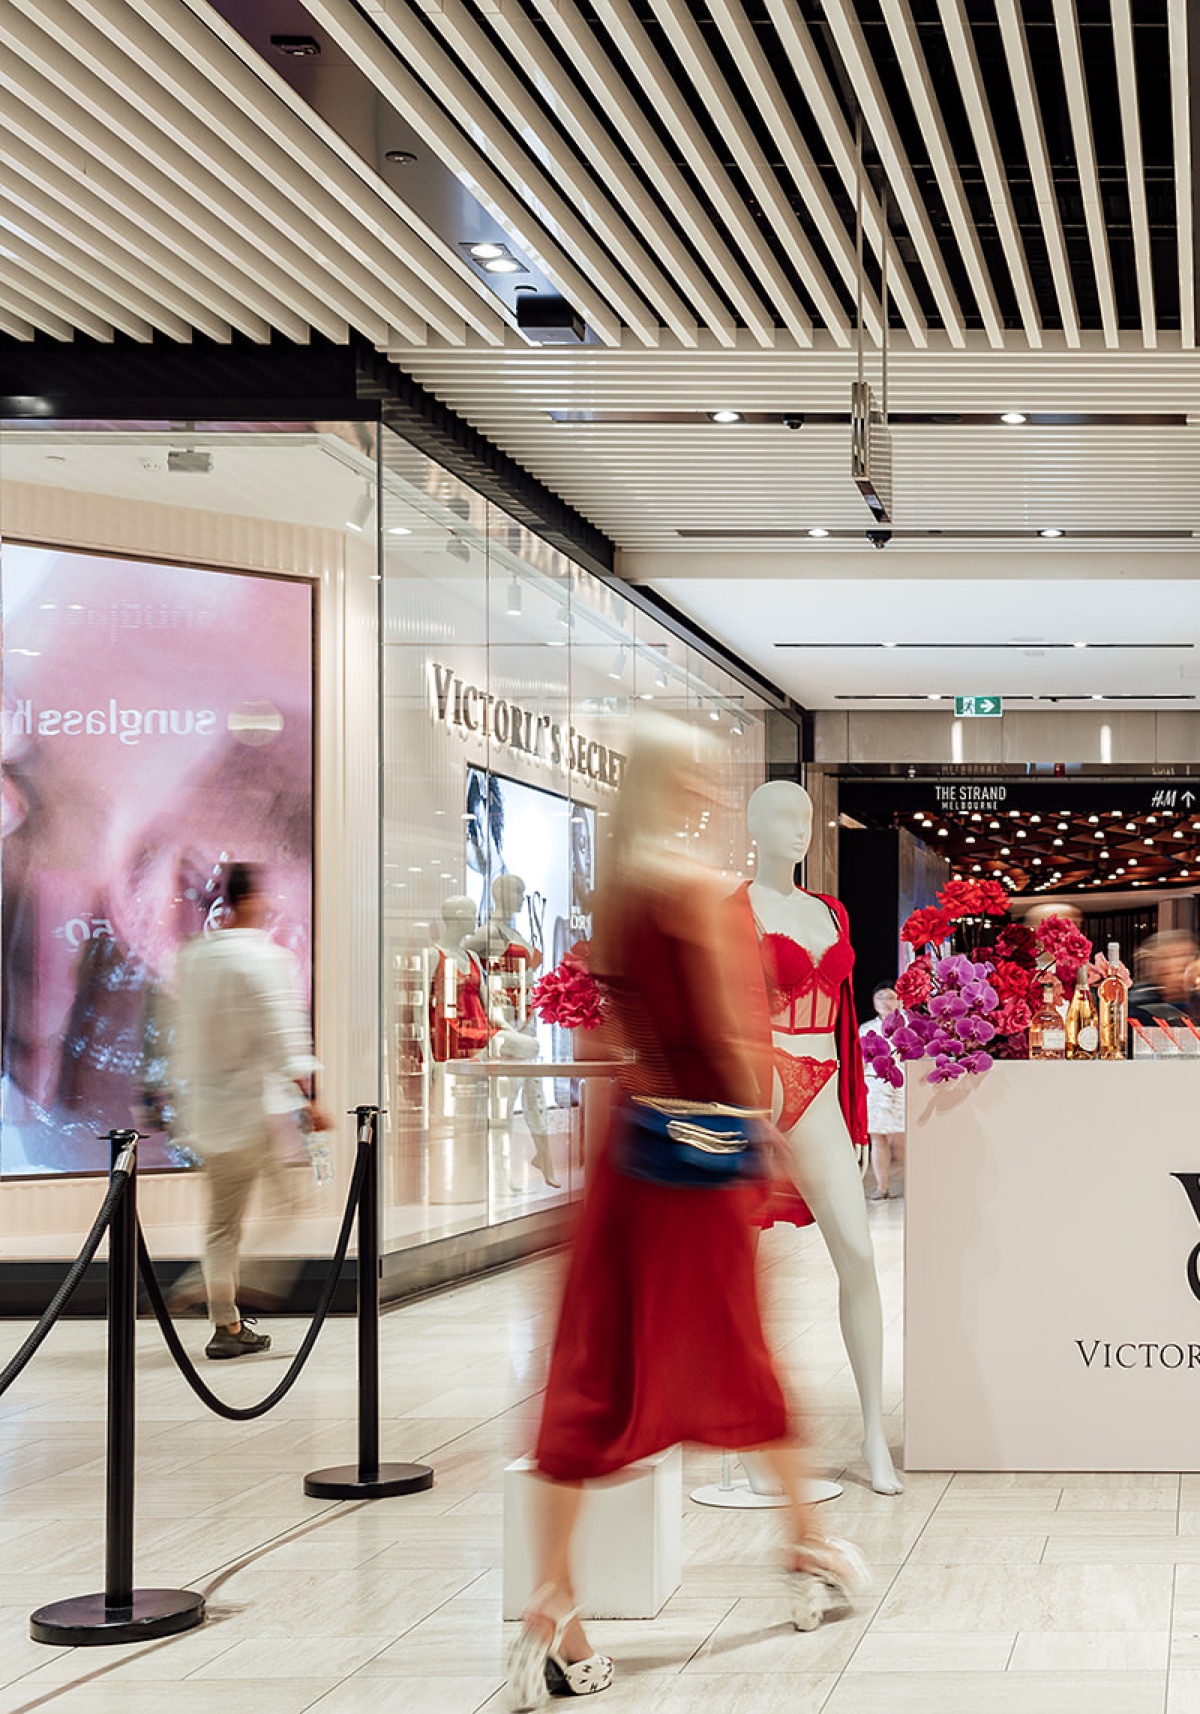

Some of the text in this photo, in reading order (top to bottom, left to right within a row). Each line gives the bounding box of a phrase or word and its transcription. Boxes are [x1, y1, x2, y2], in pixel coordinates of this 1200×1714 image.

[433, 663, 628, 789] VICTORIA'S SECRET
[935, 786, 1006, 800] THE STRAND
[941, 801, 998, 811] MELBOURNE
